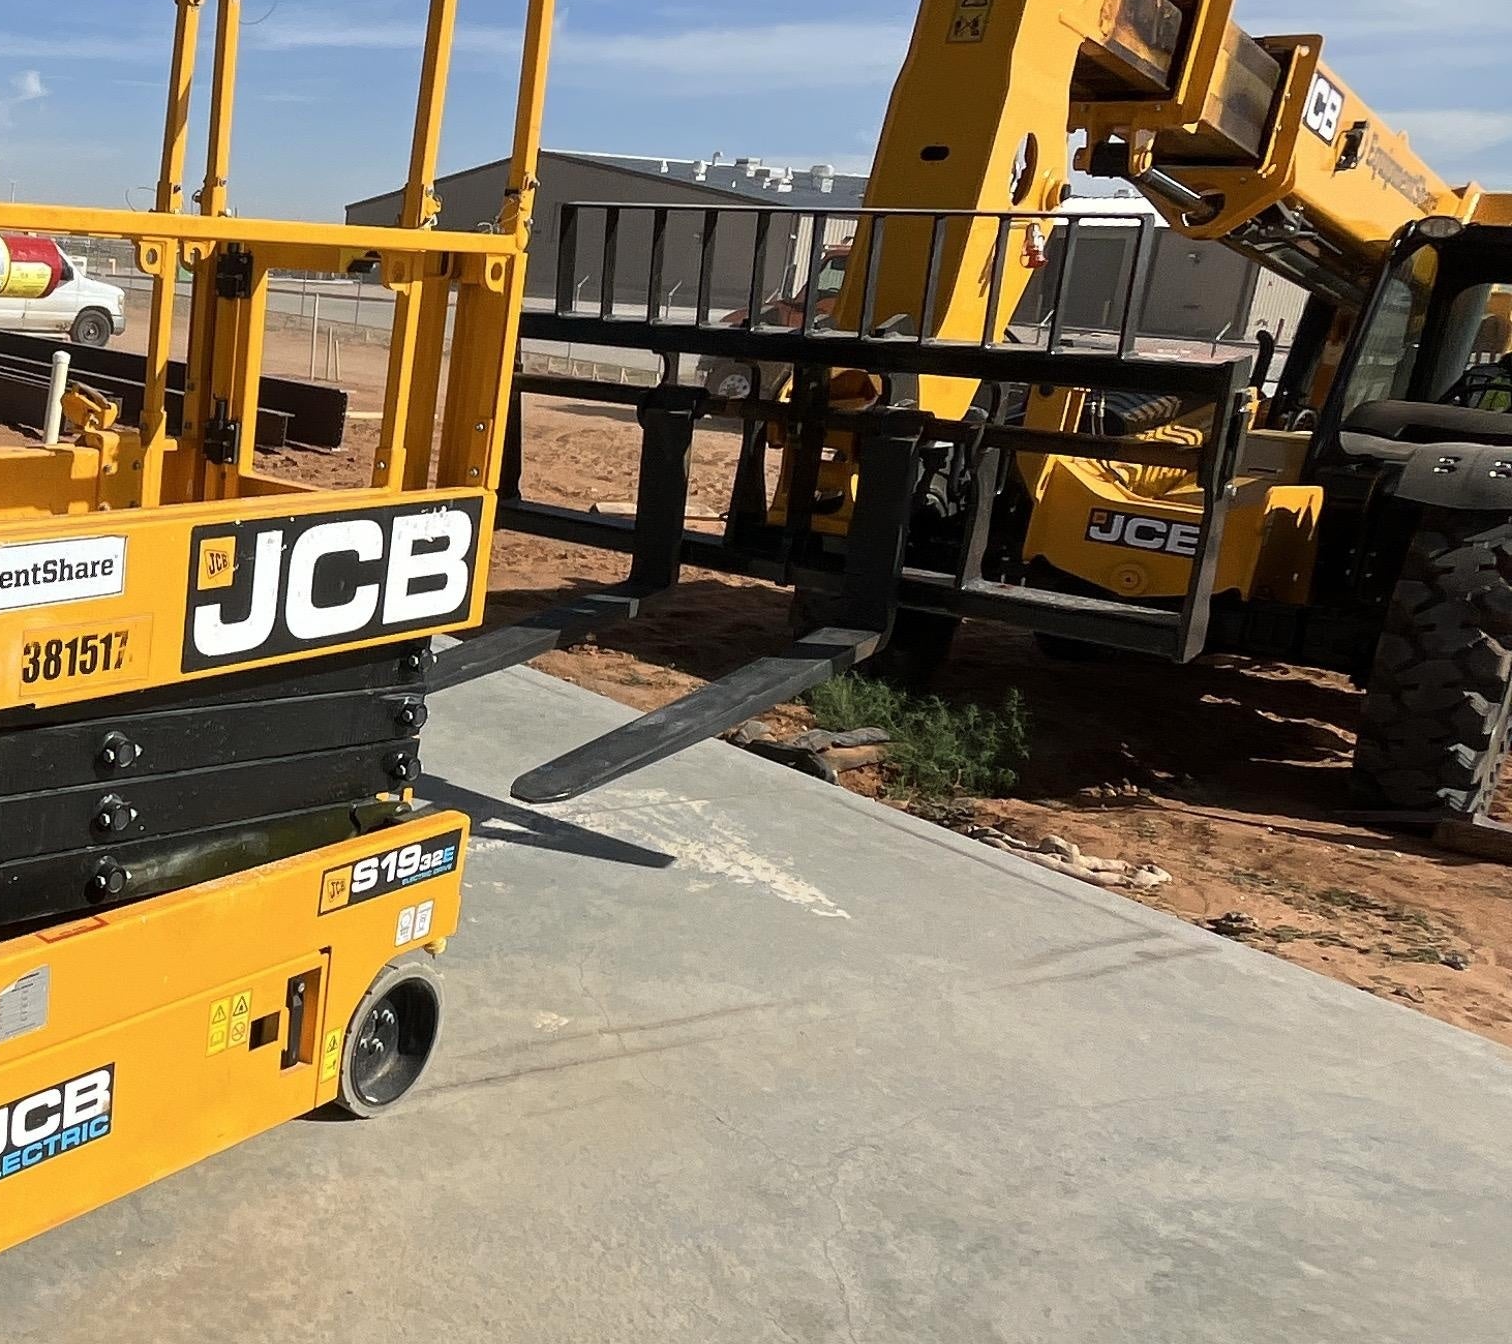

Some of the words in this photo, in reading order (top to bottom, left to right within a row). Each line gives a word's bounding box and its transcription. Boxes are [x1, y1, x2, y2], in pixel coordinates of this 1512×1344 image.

[1304, 71, 1345, 143] CB
[193, 509, 473, 657] JCB
[207, 550, 229, 576] JCB
[21, 630, 129, 684] 381517
